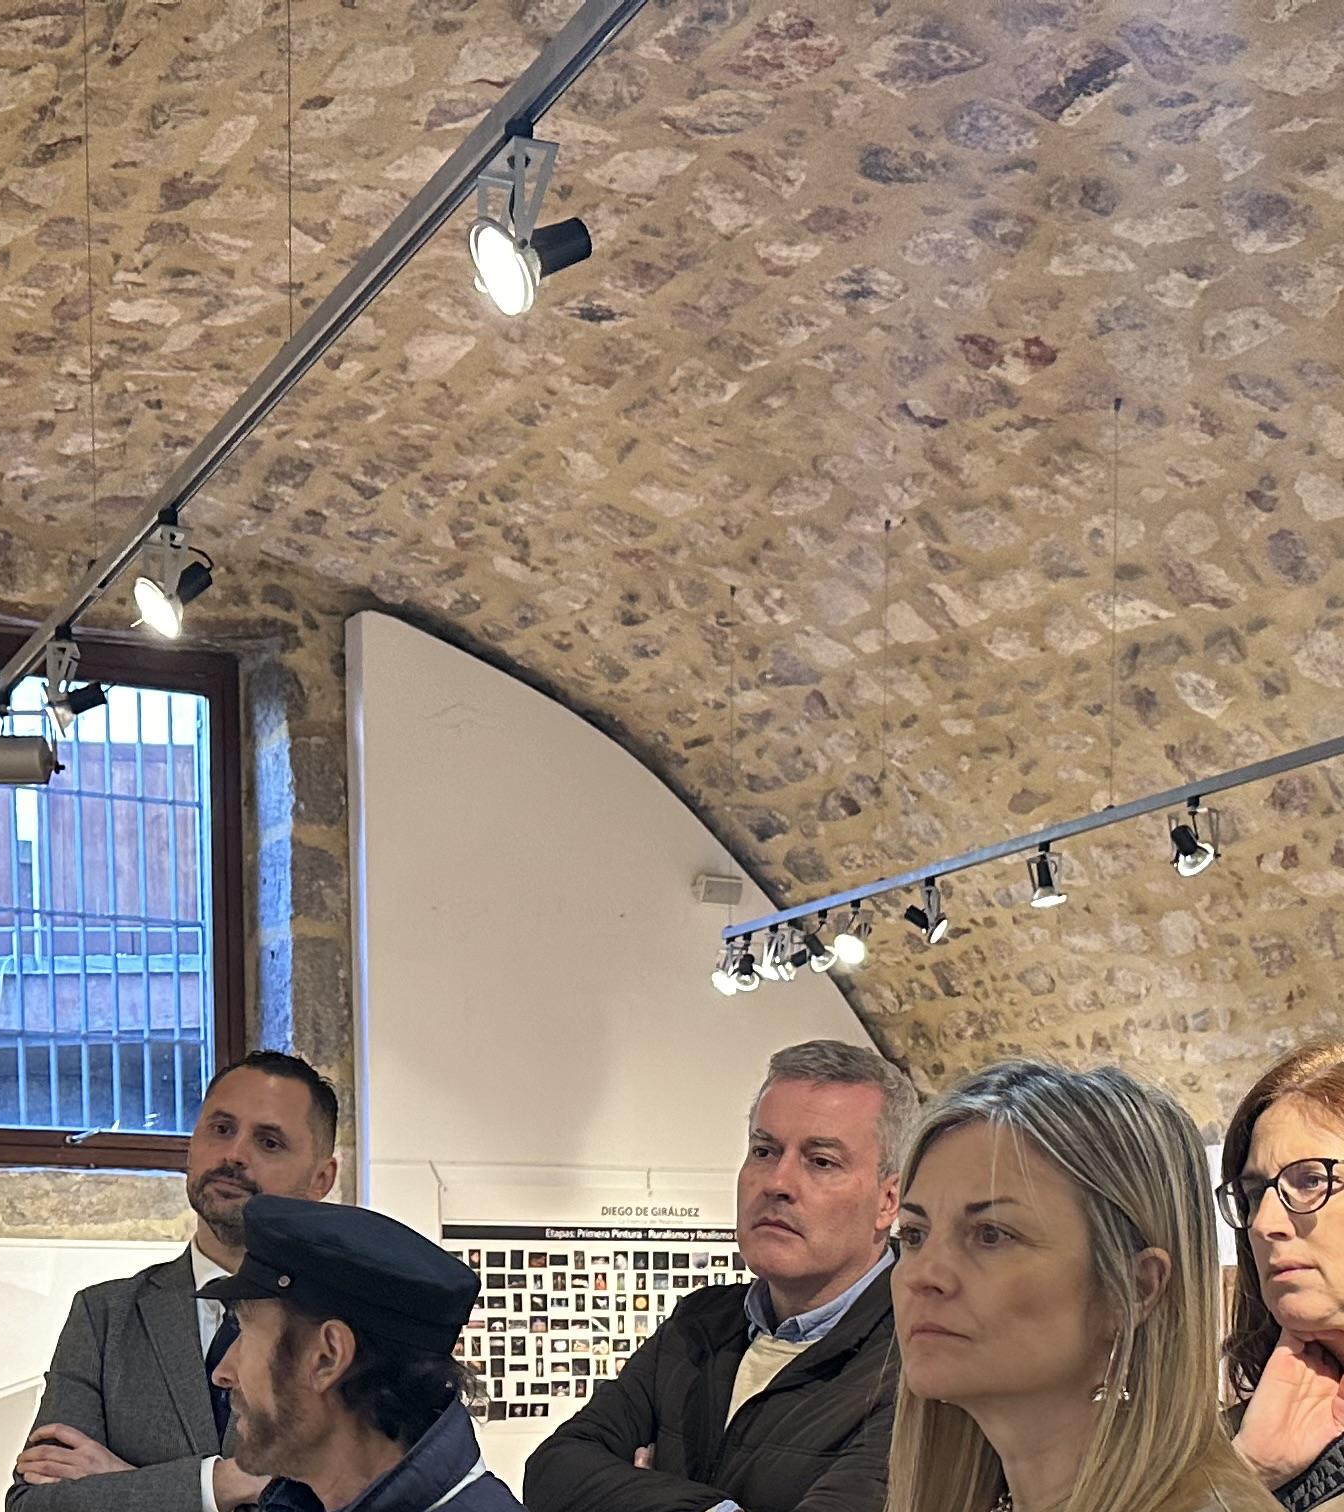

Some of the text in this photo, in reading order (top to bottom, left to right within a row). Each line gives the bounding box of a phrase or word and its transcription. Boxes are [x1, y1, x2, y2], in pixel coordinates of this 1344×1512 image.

[601, 1206, 700, 1217] DIEGO DE GIRÁLDEZ
